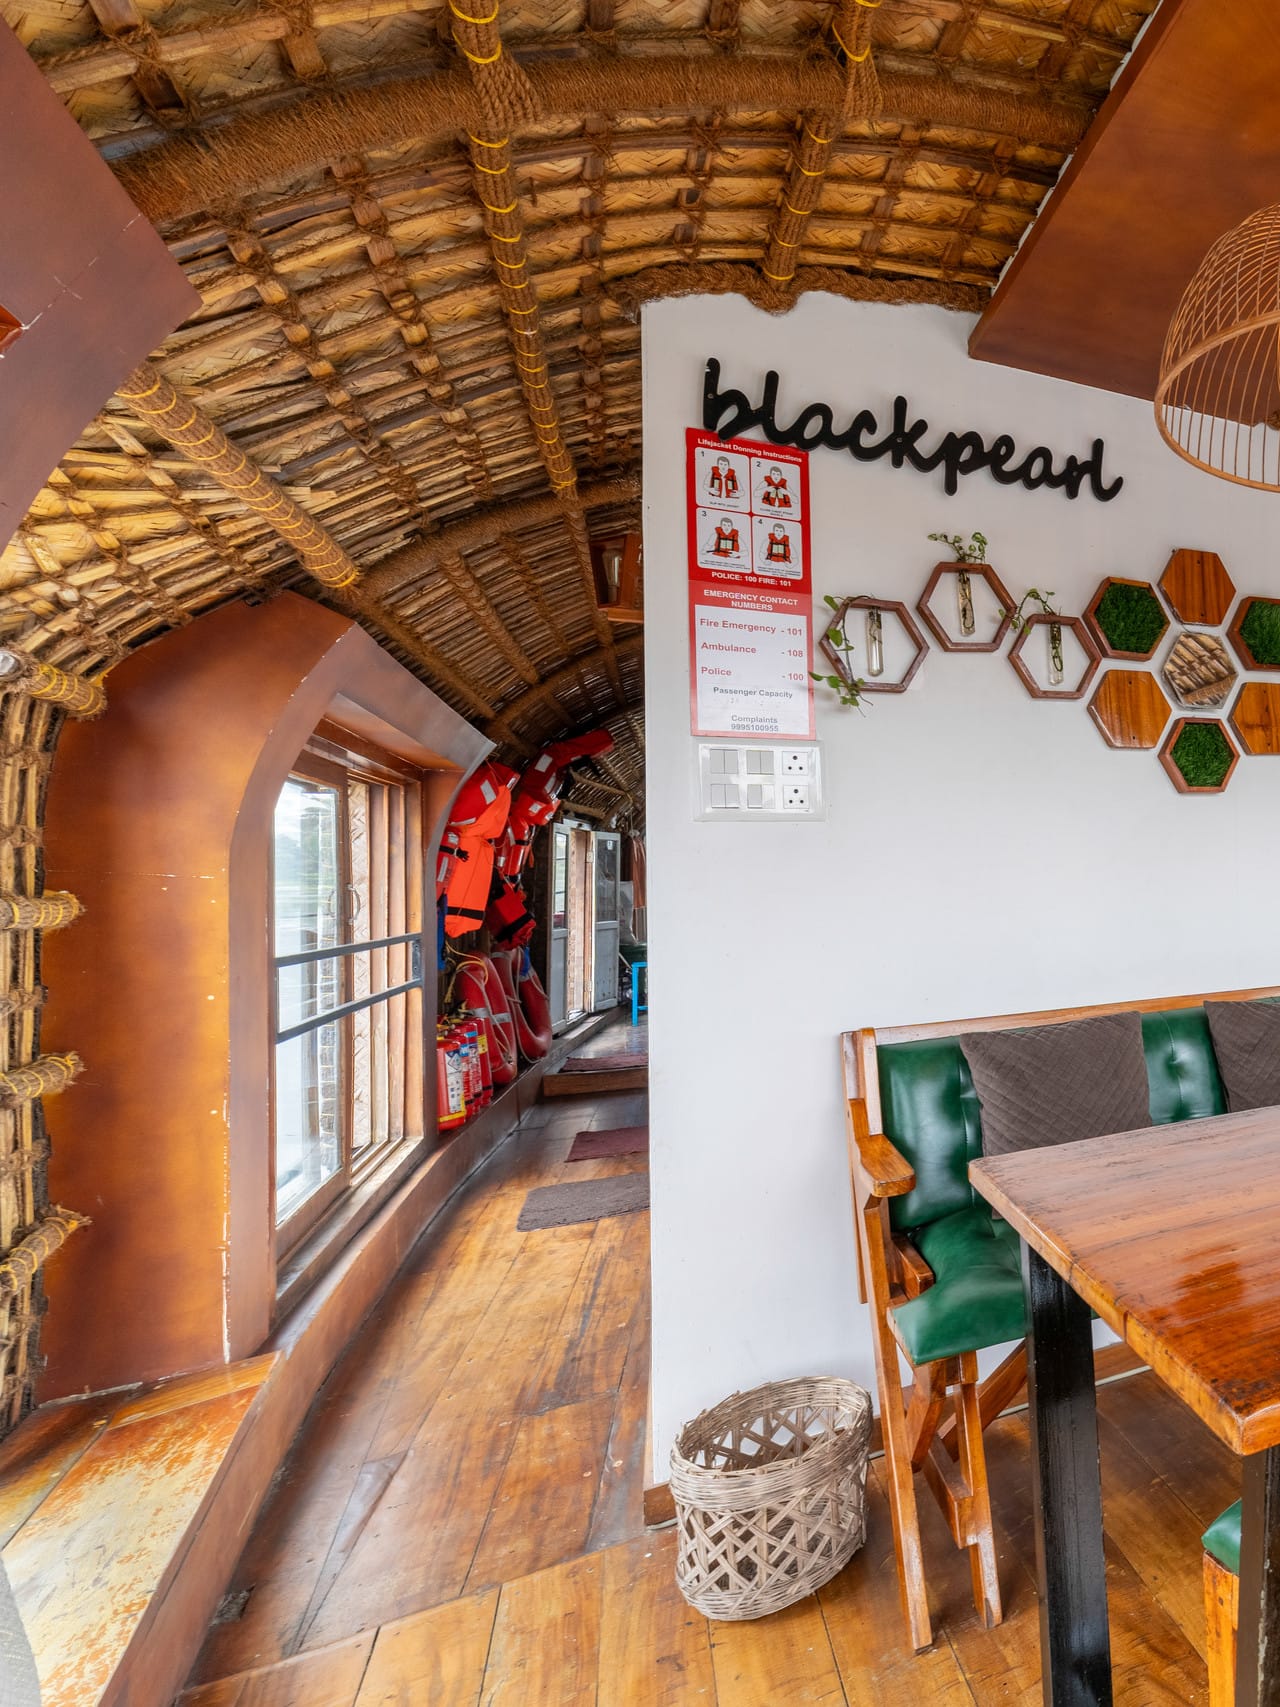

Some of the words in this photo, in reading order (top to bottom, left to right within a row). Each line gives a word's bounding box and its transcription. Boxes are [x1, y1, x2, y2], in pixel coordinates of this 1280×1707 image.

[702, 357, 1124, 502] blackpearl
[697, 438, 732, 449] Lifejacket
[733, 444, 762, 456] Donning
[763, 450, 802, 462] Instructions
[711, 571, 743, 581] POLICE:
[704, 589, 758, 601] EMERGENCY
[760, 595, 798, 606] CONTACT
[731, 601, 773, 611] NUMBERS
[700, 618, 719, 628] Fire
[722, 620, 776, 635] Emergency
[787, 628, 802, 636] 101
[701, 642, 756, 654] Ambulance
[701, 666, 732, 676] Police
[788, 673, 804, 681] 100
[713, 687, 758, 697] Passenger
[759, 690, 793, 699] Capacity
[731, 714, 778, 724] Complaints
